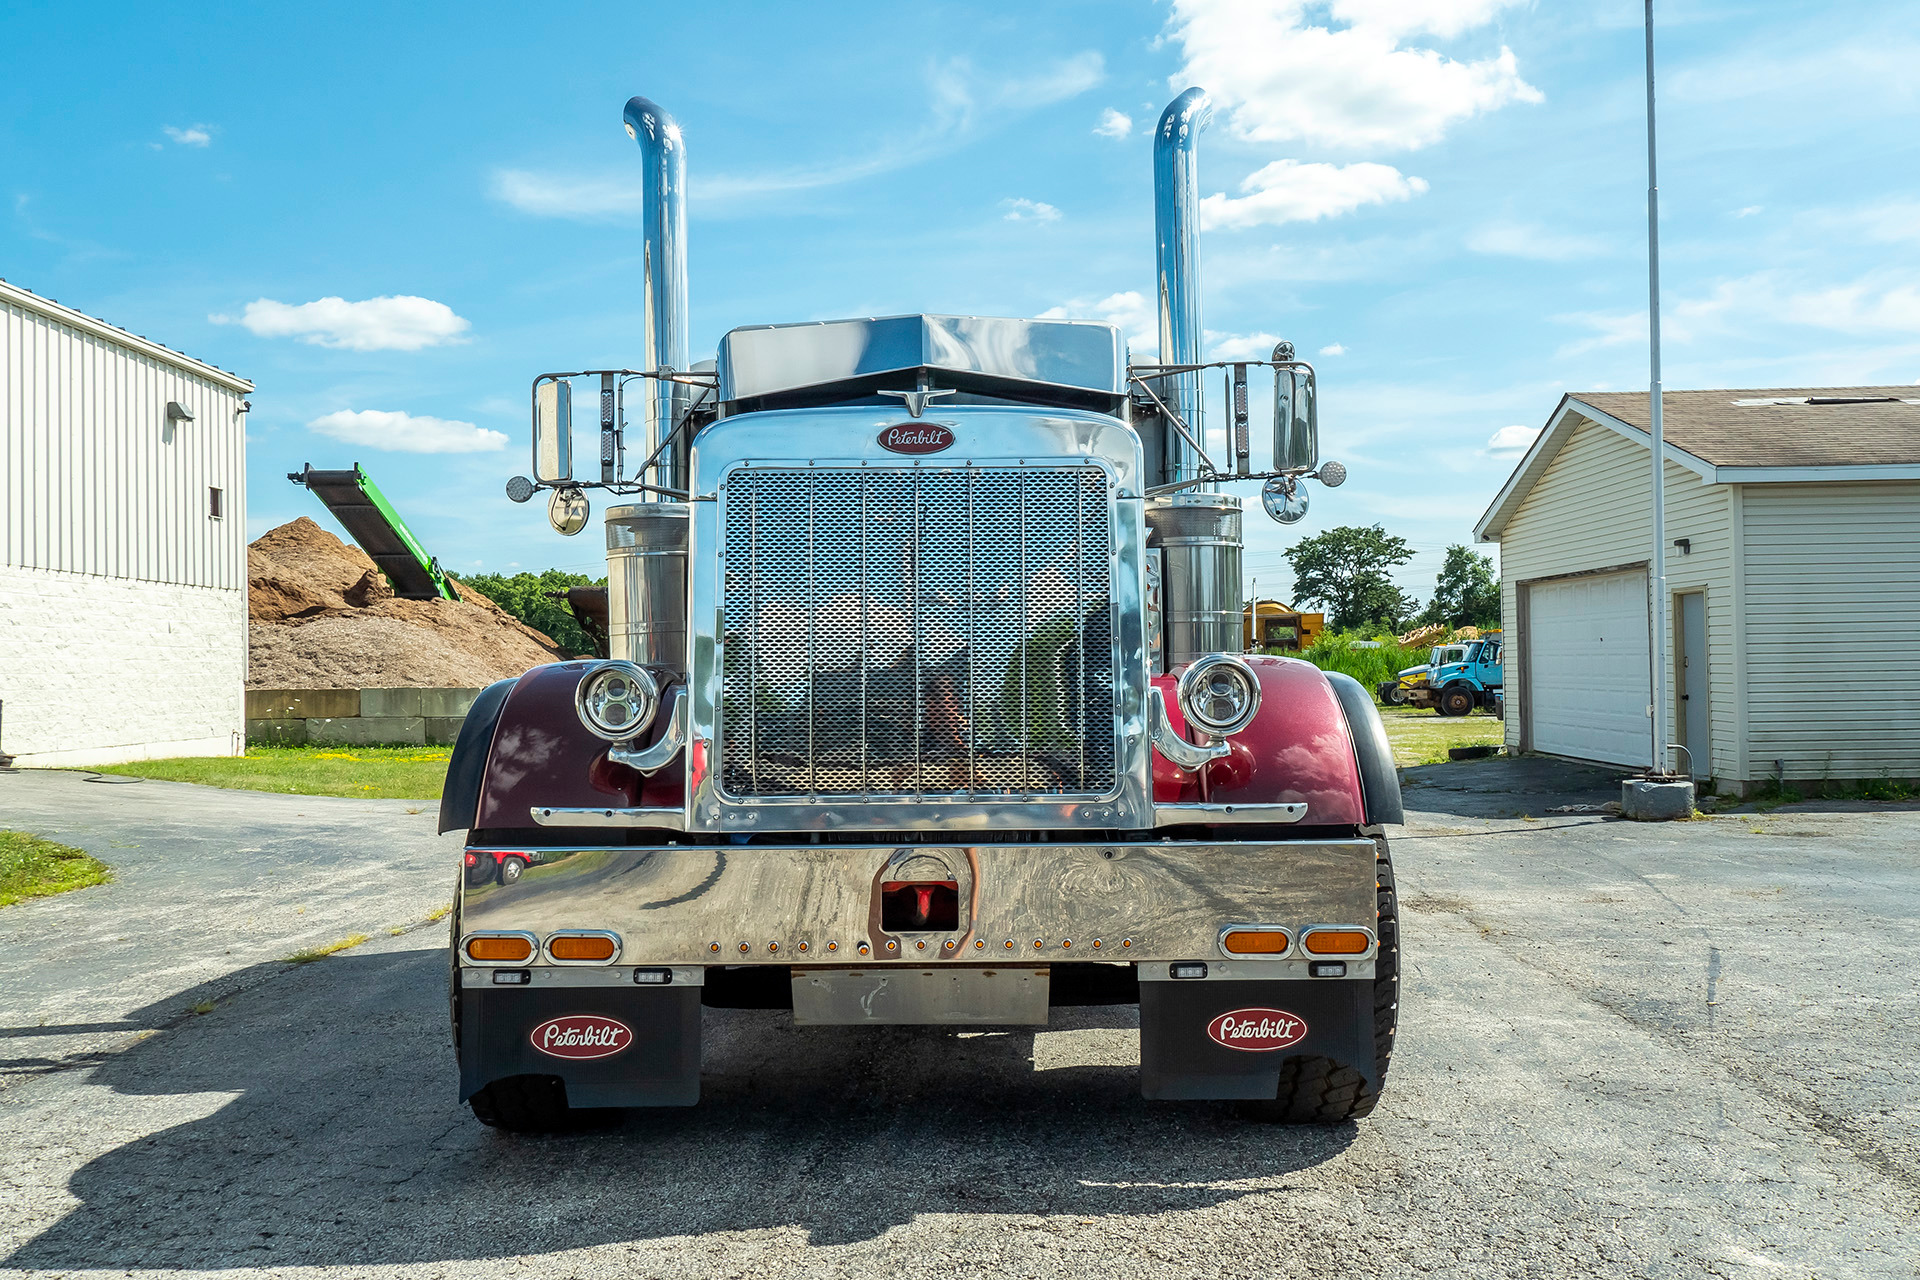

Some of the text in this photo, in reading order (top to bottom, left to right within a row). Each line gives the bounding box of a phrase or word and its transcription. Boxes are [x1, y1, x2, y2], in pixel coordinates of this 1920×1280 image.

[888, 428, 948, 446] Peterbilt
[543, 1024, 624, 1049] Peterbilt
[1220, 1016, 1299, 1041] Peterbilt
